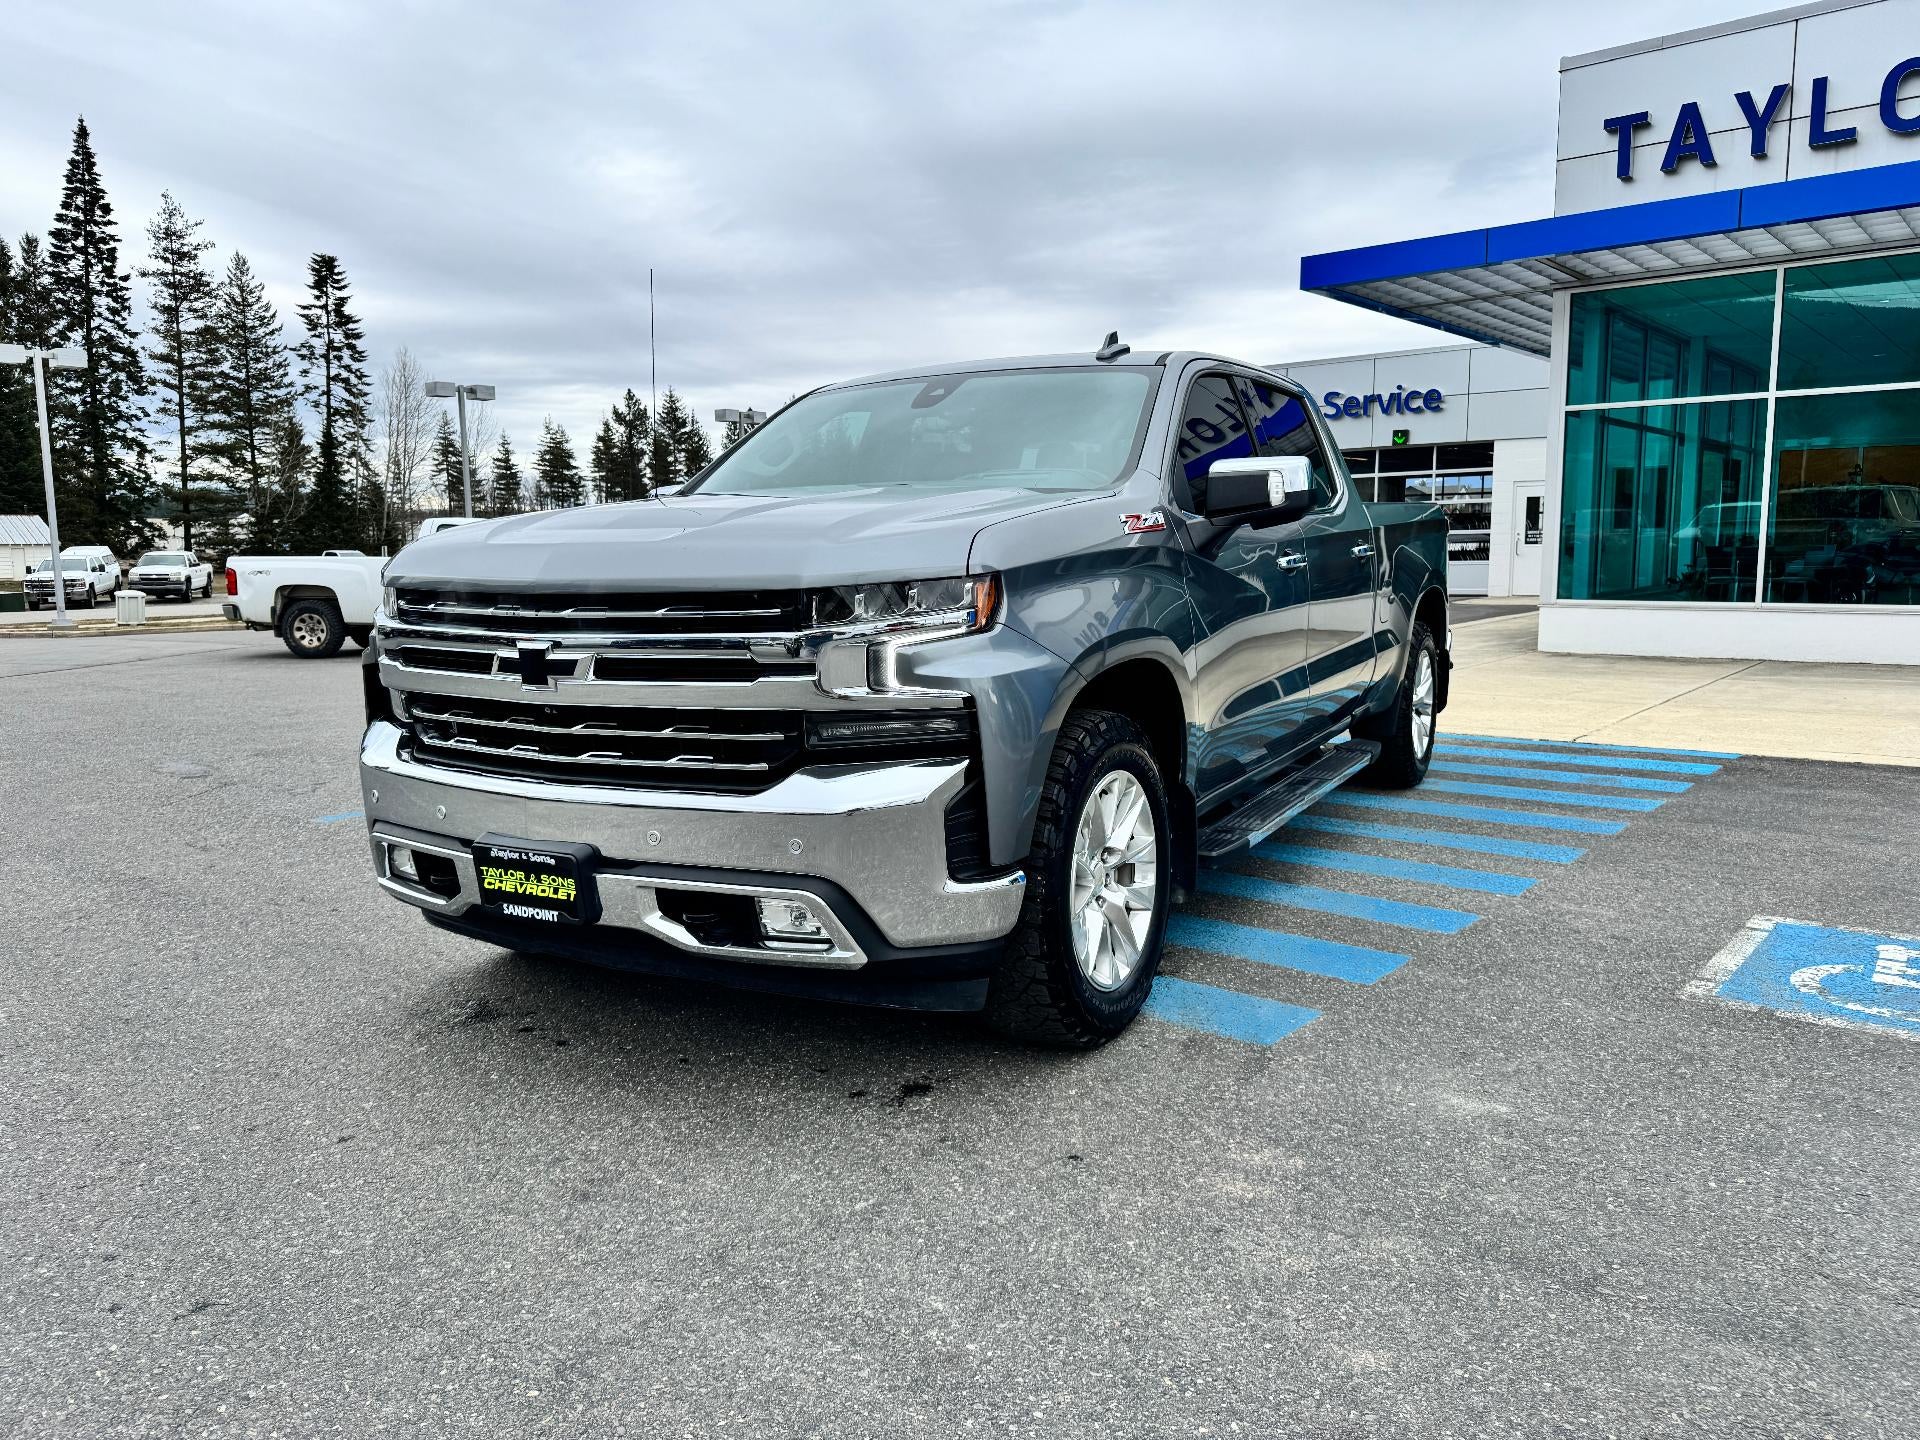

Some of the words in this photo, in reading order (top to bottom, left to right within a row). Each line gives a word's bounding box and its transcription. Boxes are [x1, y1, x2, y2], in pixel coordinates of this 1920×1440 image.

[1323, 385, 1443, 419] Service
[491, 848, 520, 860] Taylor
[529, 853, 555, 865] Sons
[480, 867, 525, 880] TAYLOR
[530, 874, 538, 884] &
[541, 875, 575, 888] SONS
[484, 879, 576, 901] CHEVROLET
[503, 904, 558, 922] SANDPOINT
